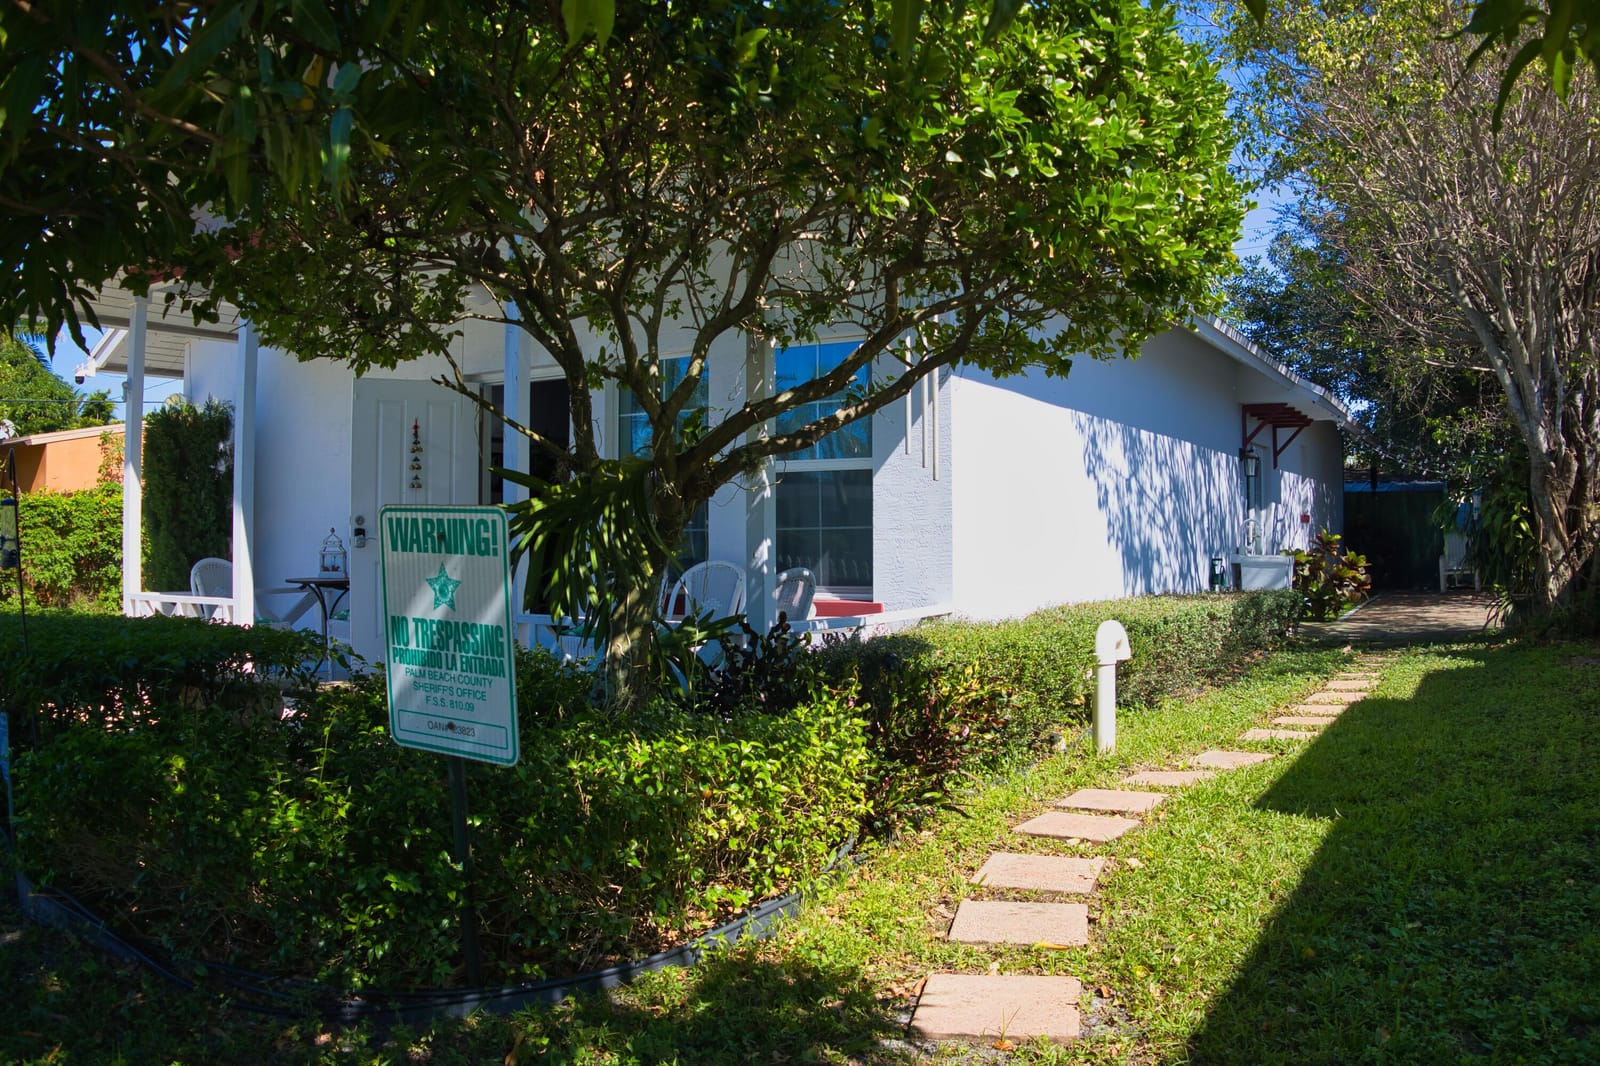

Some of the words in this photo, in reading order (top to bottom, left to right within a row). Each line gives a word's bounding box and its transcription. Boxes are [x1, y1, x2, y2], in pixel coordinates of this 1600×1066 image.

[387, 517, 498, 557] WARNING!
[391, 616, 410, 647] NO
[412, 618, 504, 658] TRESPASSING
[392, 649, 442, 670] PROHIBIDO
[445, 653, 458, 672] LA
[460, 655, 506, 679] ENTRADA
[405, 667, 426, 678] PALM
[428, 670, 456, 683] BEACH
[457, 674, 493, 688] COUNTY
[413, 681, 454, 696] SHERIFF'S
[456, 687, 487, 701] OFFICE
[449, 699, 475, 712] 810.09
